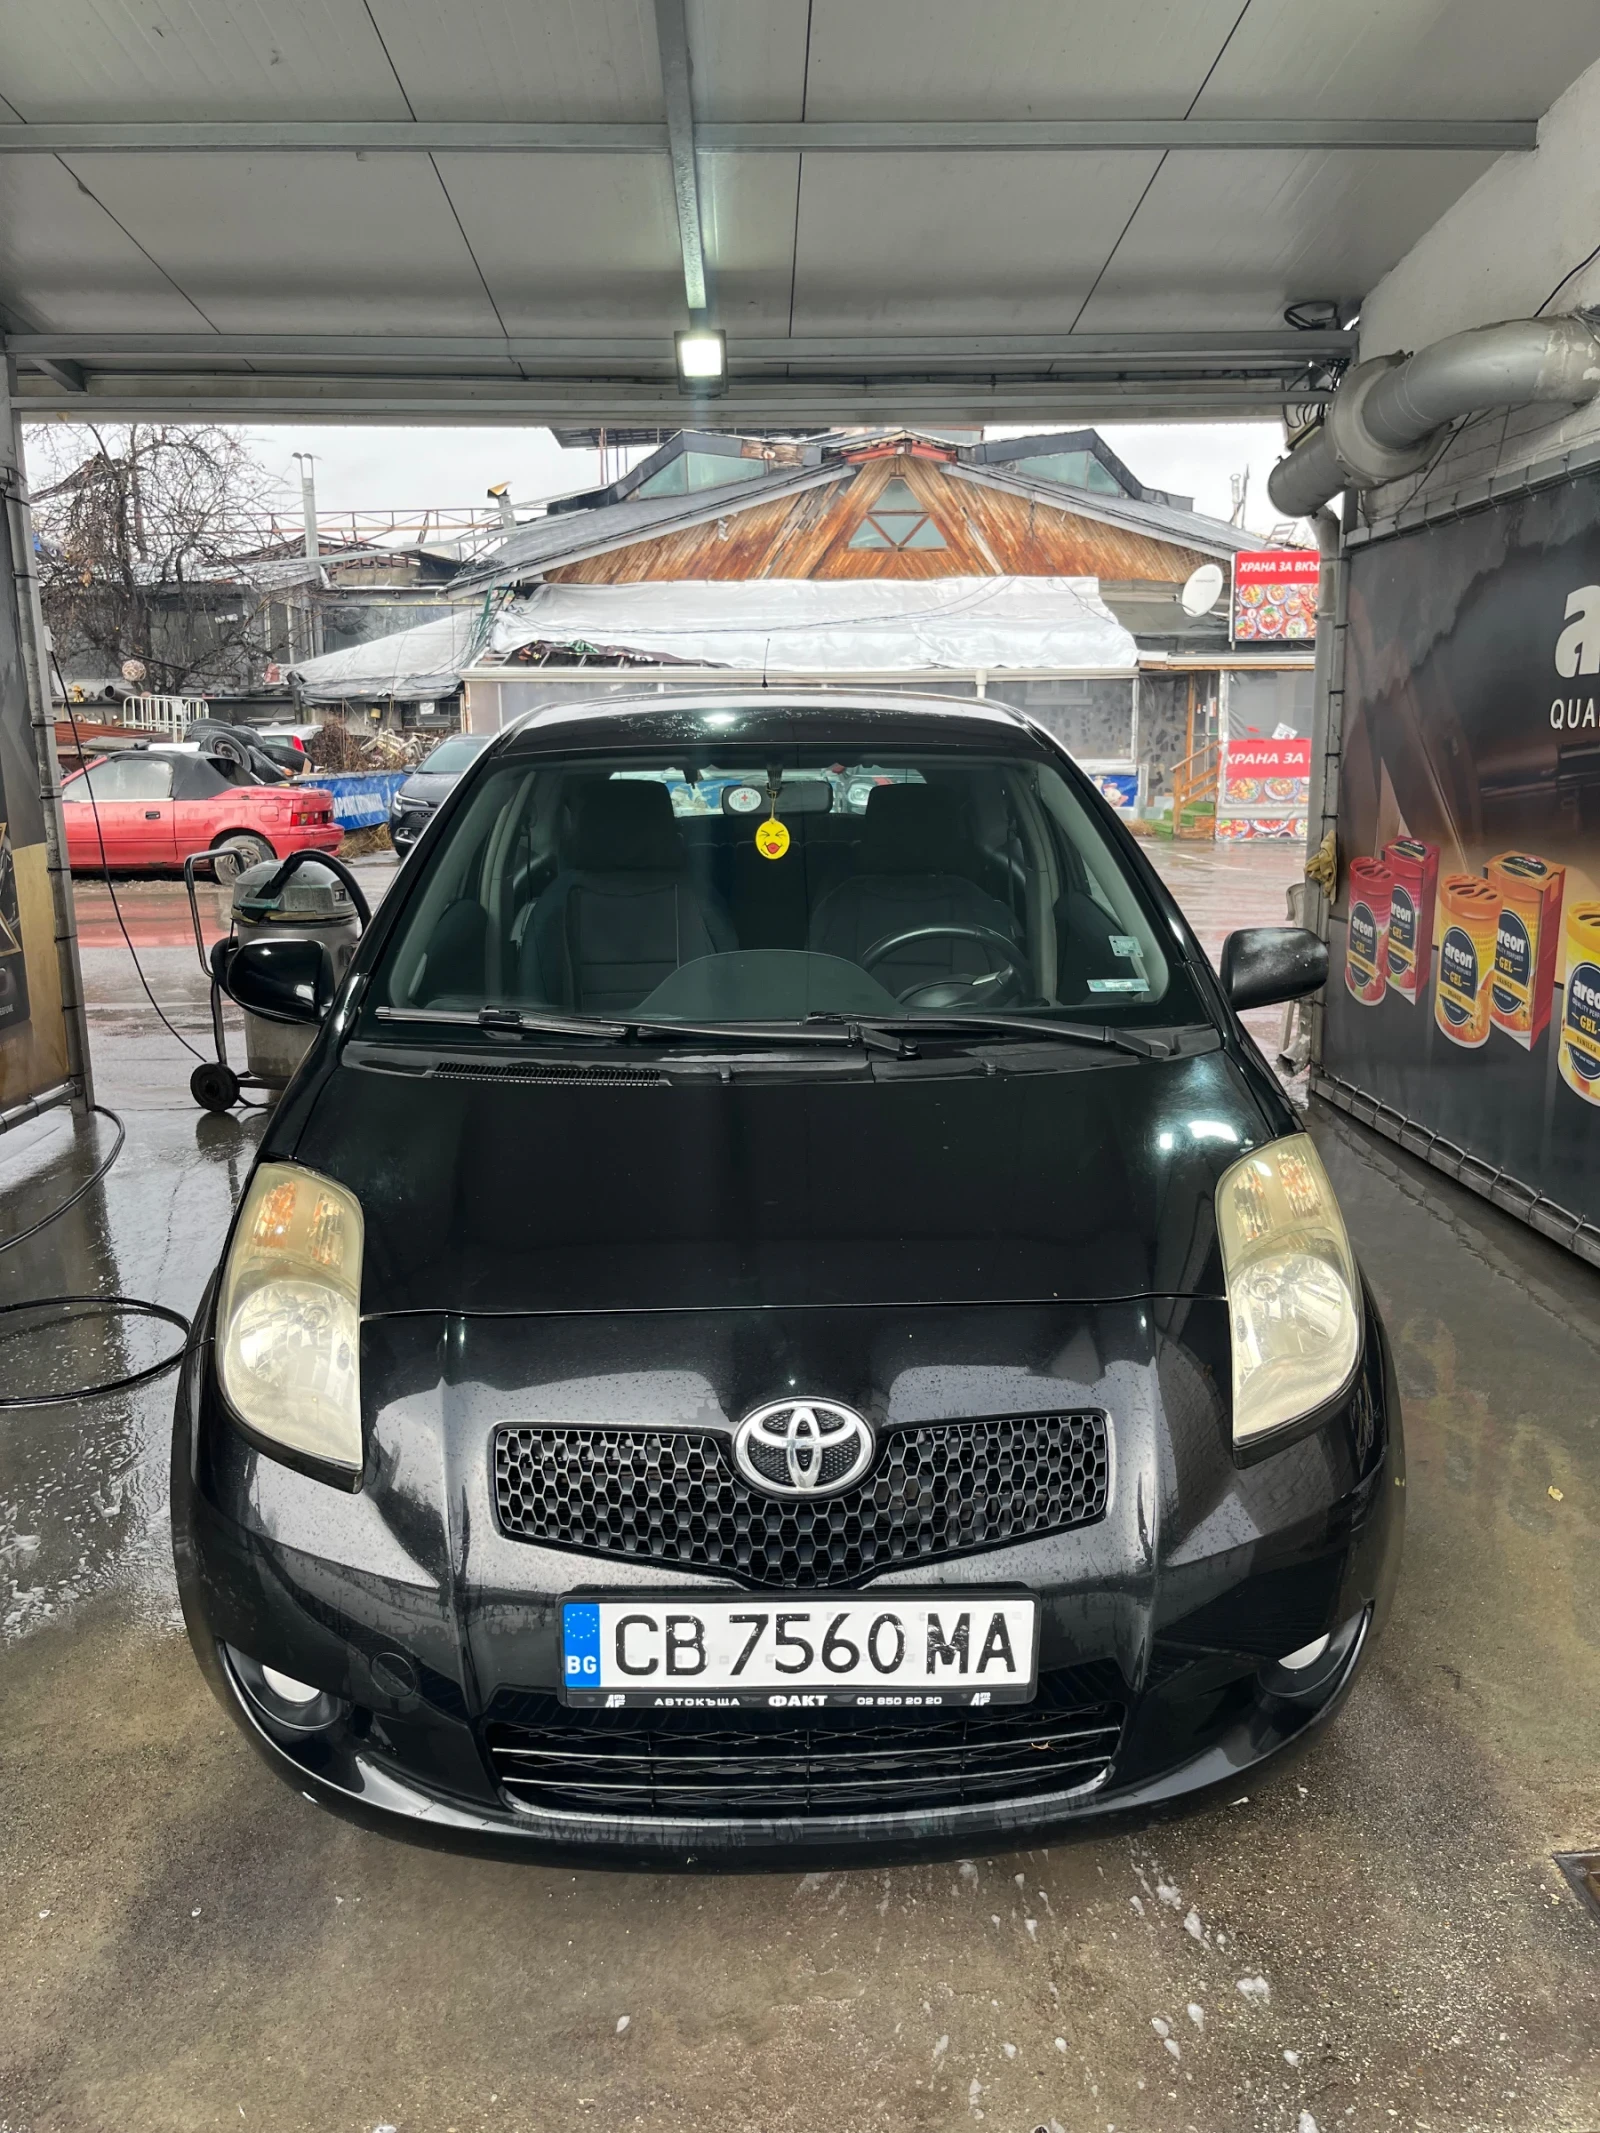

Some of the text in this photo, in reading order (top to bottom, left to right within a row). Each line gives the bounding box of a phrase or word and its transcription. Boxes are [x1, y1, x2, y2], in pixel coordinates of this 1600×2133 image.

[1239, 561, 1320, 573] ХРАНА ЗА ВКЪ
[1550, 698, 1600, 730] QUA
[1227, 752, 1279, 765] ХРАНА
[1282, 752, 1304, 764] ЗА
[1352, 915, 1374, 939] areon
[1444, 942, 1473, 970] areon
[1499, 956, 1513, 974] GEL
[1449, 970, 1463, 988] GEL
[1580, 1014, 1598, 1035] GEL
[1576, 1035, 1597, 1053] VANILLA
[615, 1612, 1017, 1676] CB 7560 MA
[567, 1654, 598, 1675] BG
[768, 1694, 829, 1708] ФАКТ
[856, 1696, 874, 1706] 02
[904, 1696, 923, 1706] 20
[924, 1696, 943, 1706] 20
